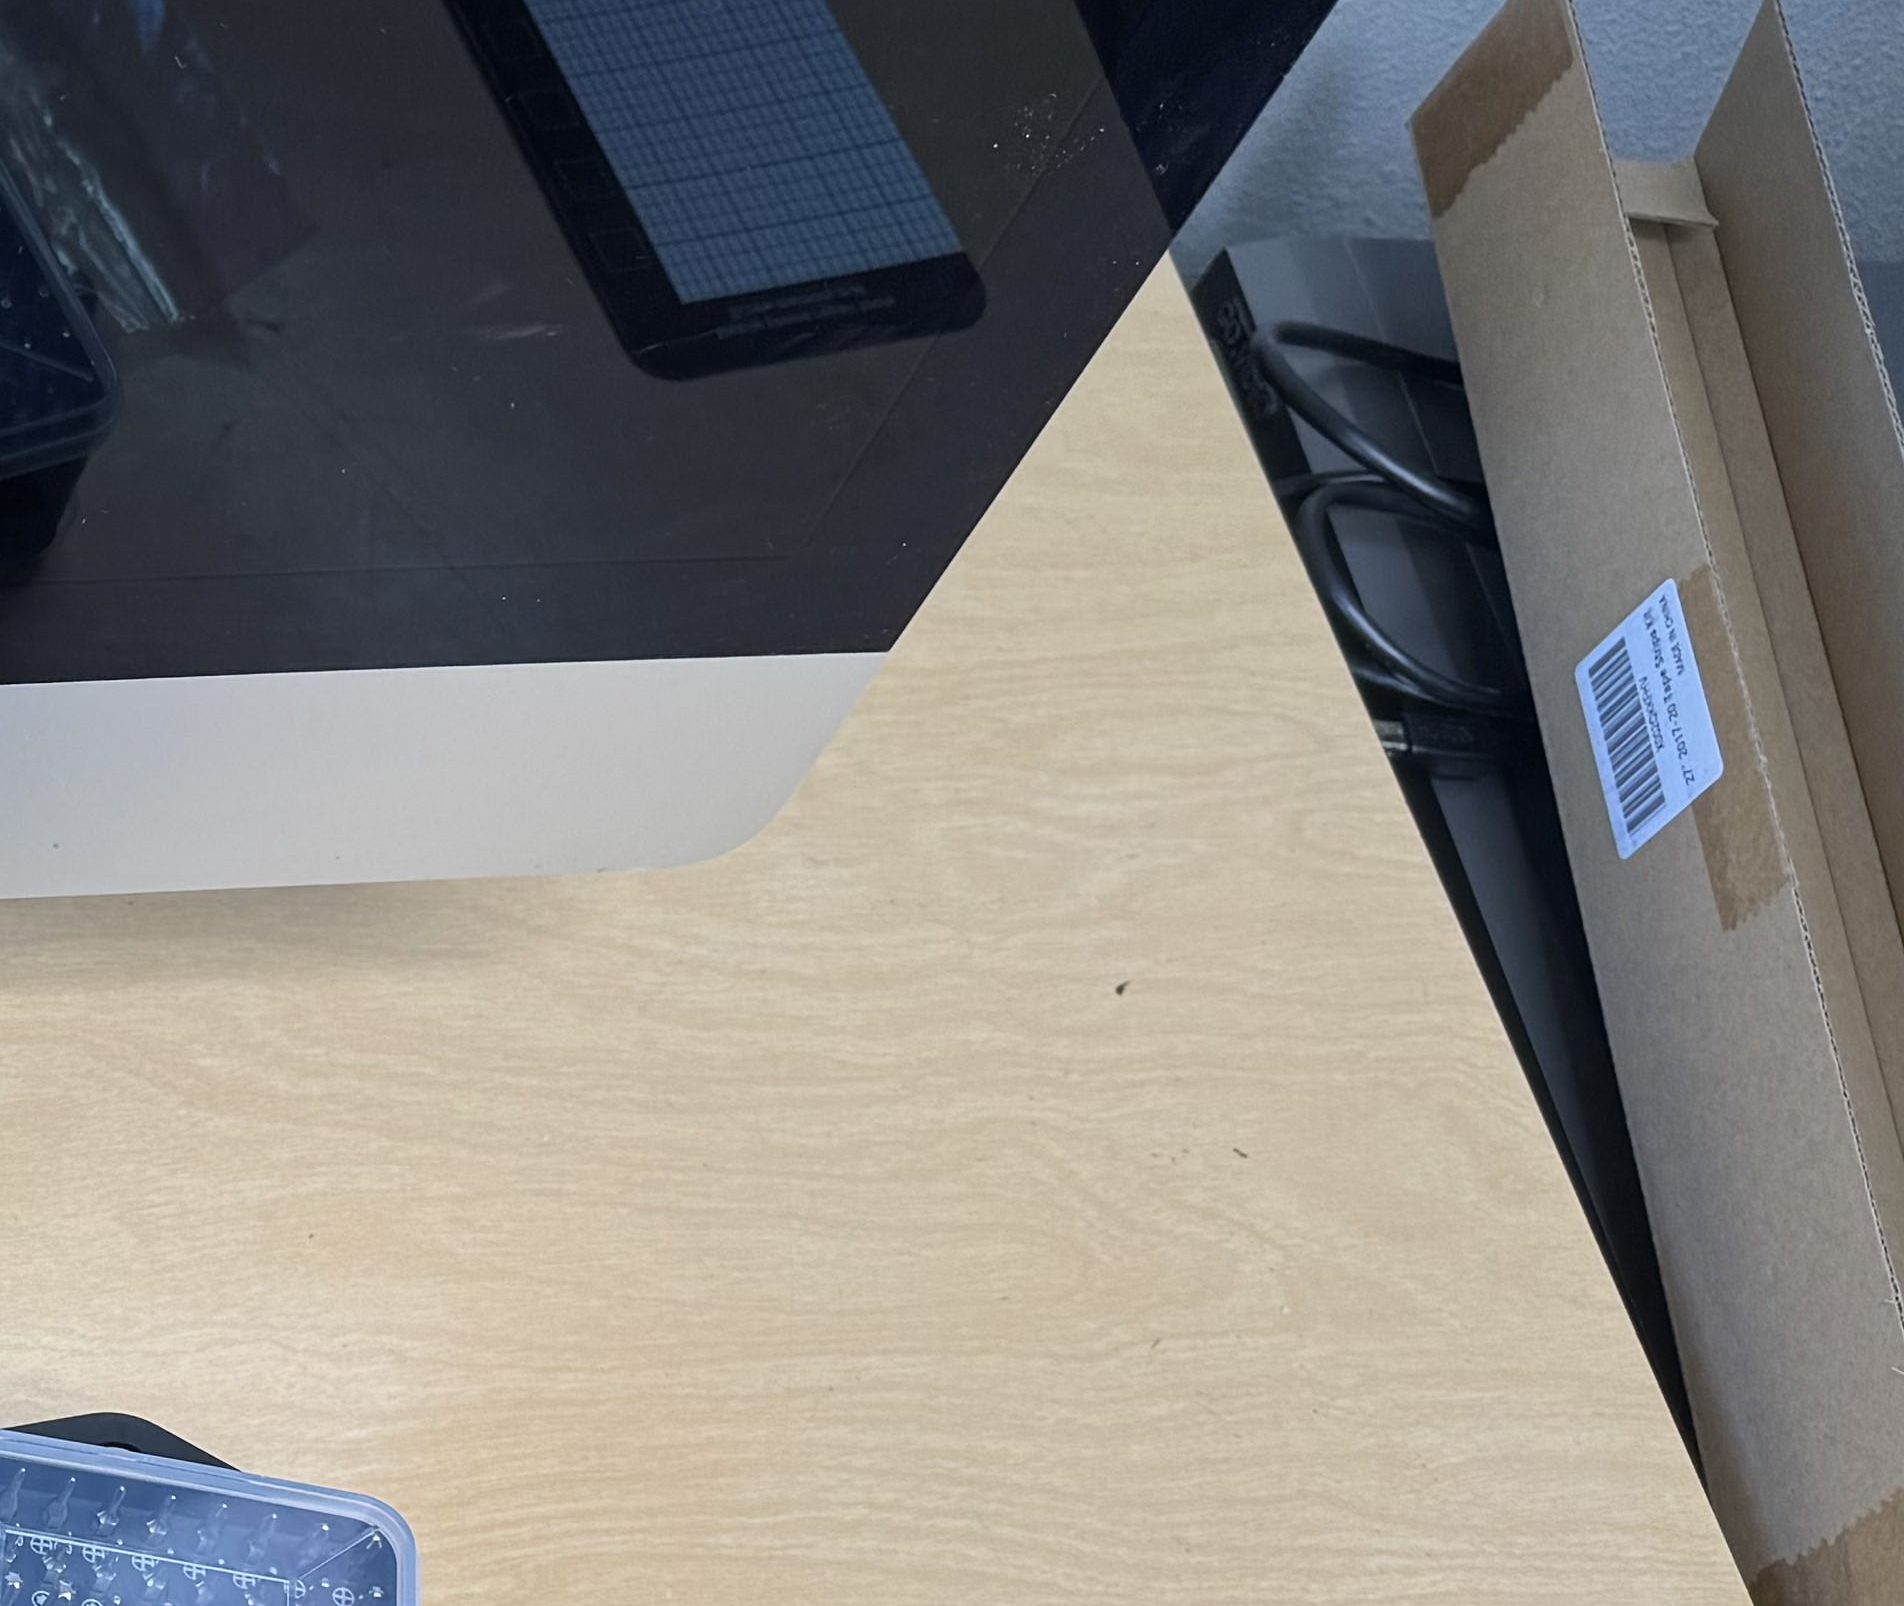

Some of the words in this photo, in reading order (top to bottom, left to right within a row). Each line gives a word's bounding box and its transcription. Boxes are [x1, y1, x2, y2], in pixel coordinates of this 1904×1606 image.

[1643, 608, 1654, 630] Kit
[1659, 594, 1673, 629] CHINA
[1650, 628, 1664, 668] Strips
[1668, 628, 1676, 642] IN
[1671, 642, 1684, 676] MADE
[1660, 669, 1672, 703] Tape
[1667, 703, 1687, 760] 2017-20
